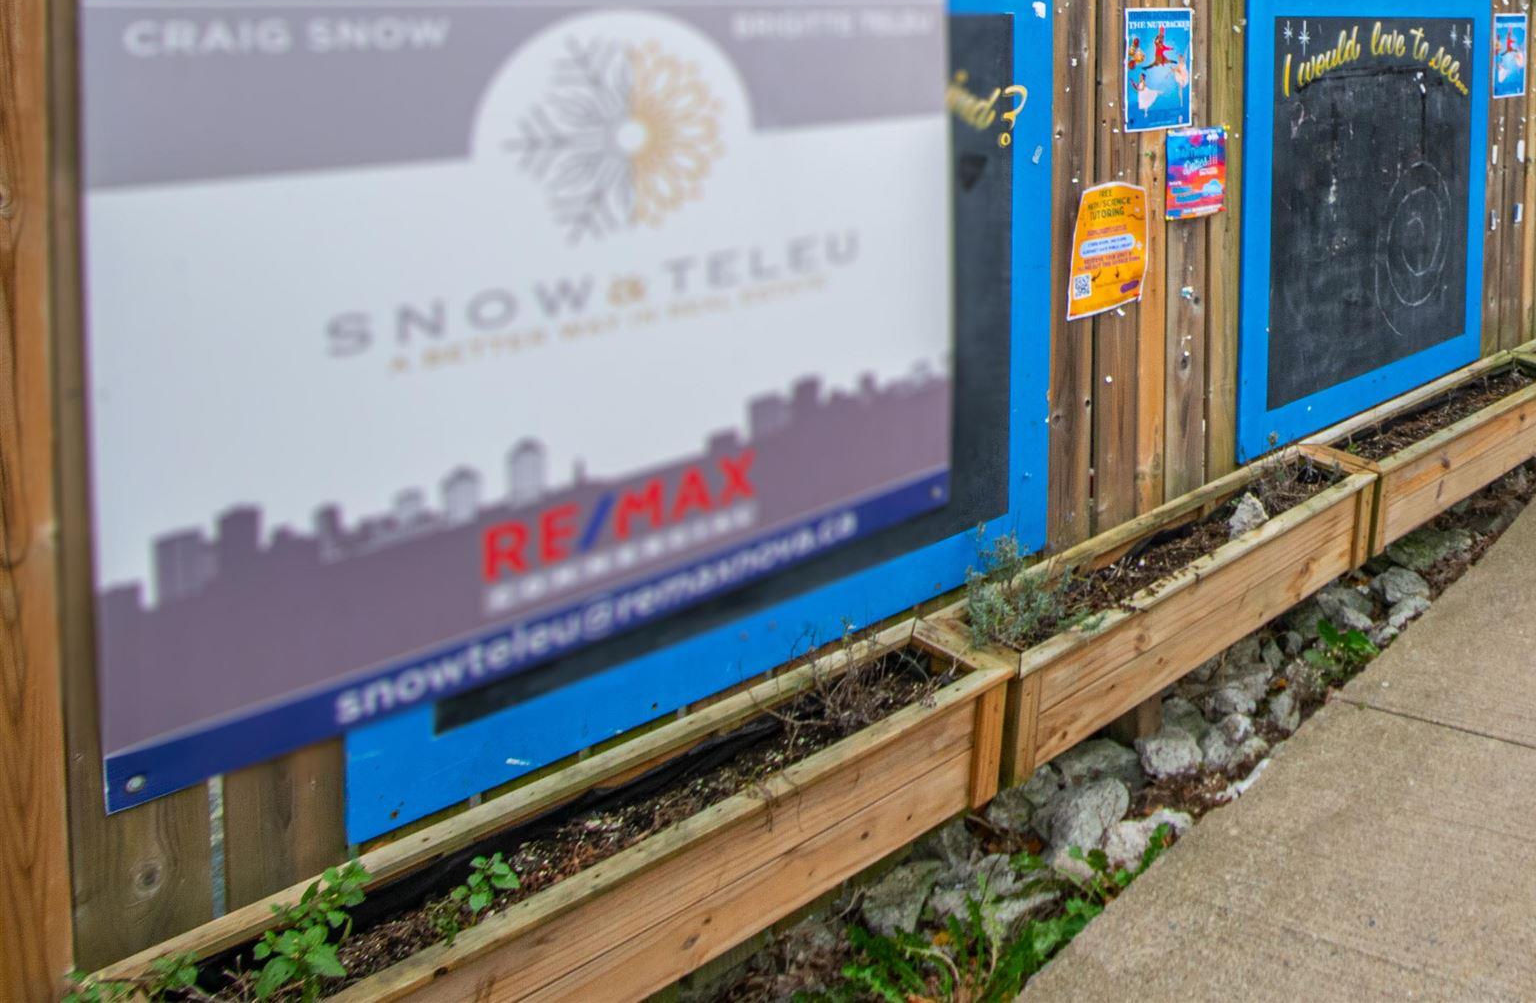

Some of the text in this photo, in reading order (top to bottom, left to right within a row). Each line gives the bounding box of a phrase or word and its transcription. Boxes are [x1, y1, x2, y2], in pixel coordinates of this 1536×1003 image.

[123, 17, 449, 55] CRAIG SNOW
[1297, 25, 1361, 86] would
[1370, 21, 1406, 57] love
[1410, 27, 1430, 61] to
[325, 274, 594, 359] SNOW
[662, 229, 860, 294] TELEU
[482, 447, 758, 581] RE/MAX
